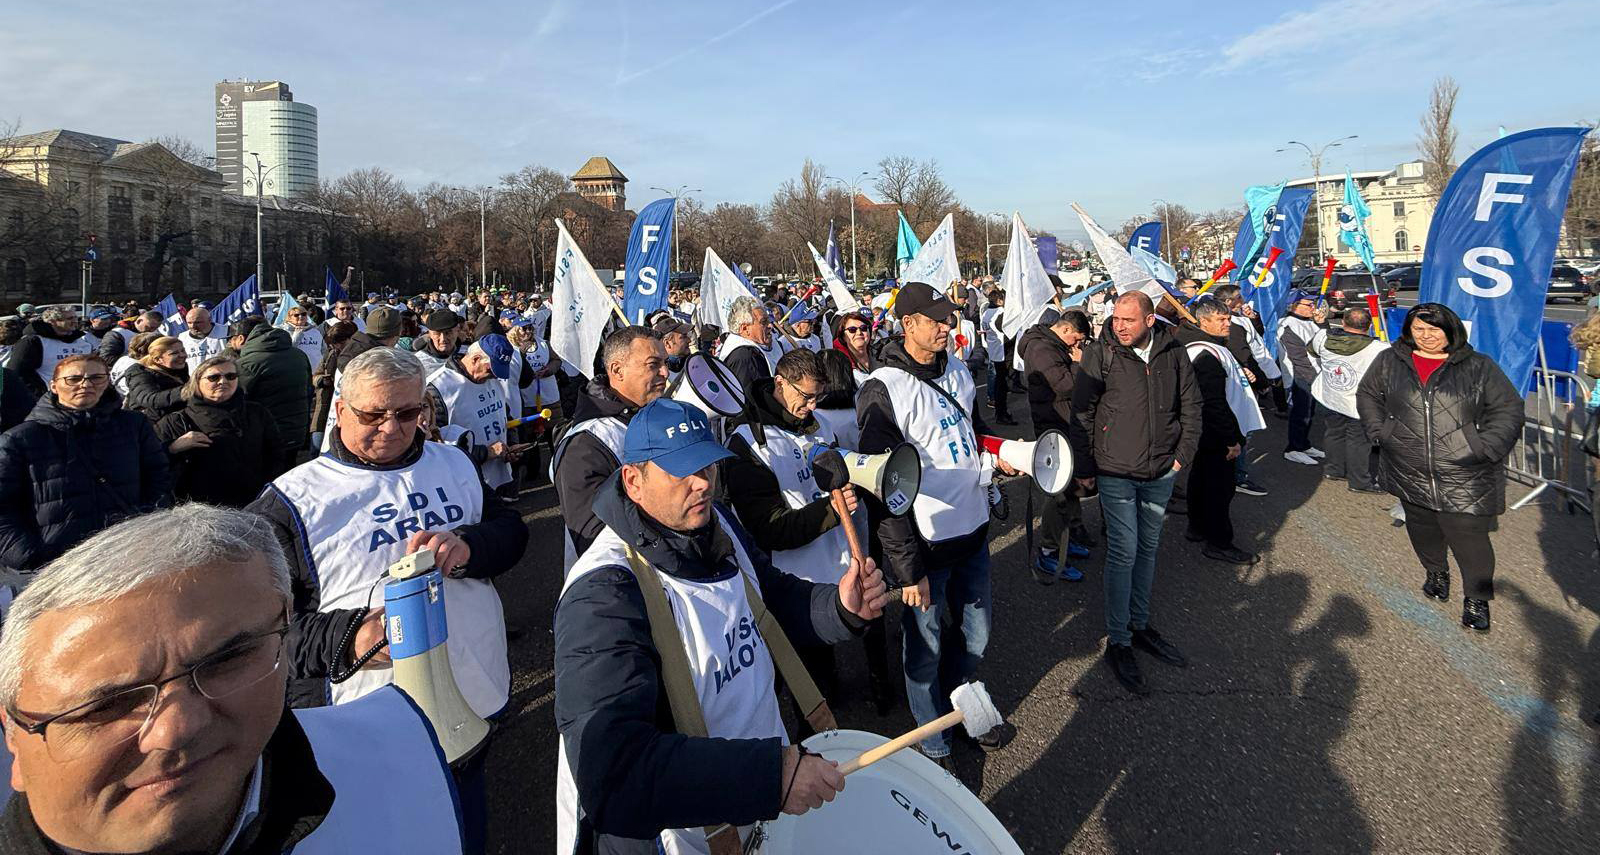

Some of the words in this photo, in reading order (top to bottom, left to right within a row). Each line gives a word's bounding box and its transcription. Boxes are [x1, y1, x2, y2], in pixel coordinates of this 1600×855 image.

[244, 85, 255, 93] EY
[484, 420, 506, 441] FS
[666, 420, 706, 439] FSLI
[372, 486, 448, 524] SDI
[887, 493, 907, 510] SLI
[368, 504, 464, 553] ARAD
